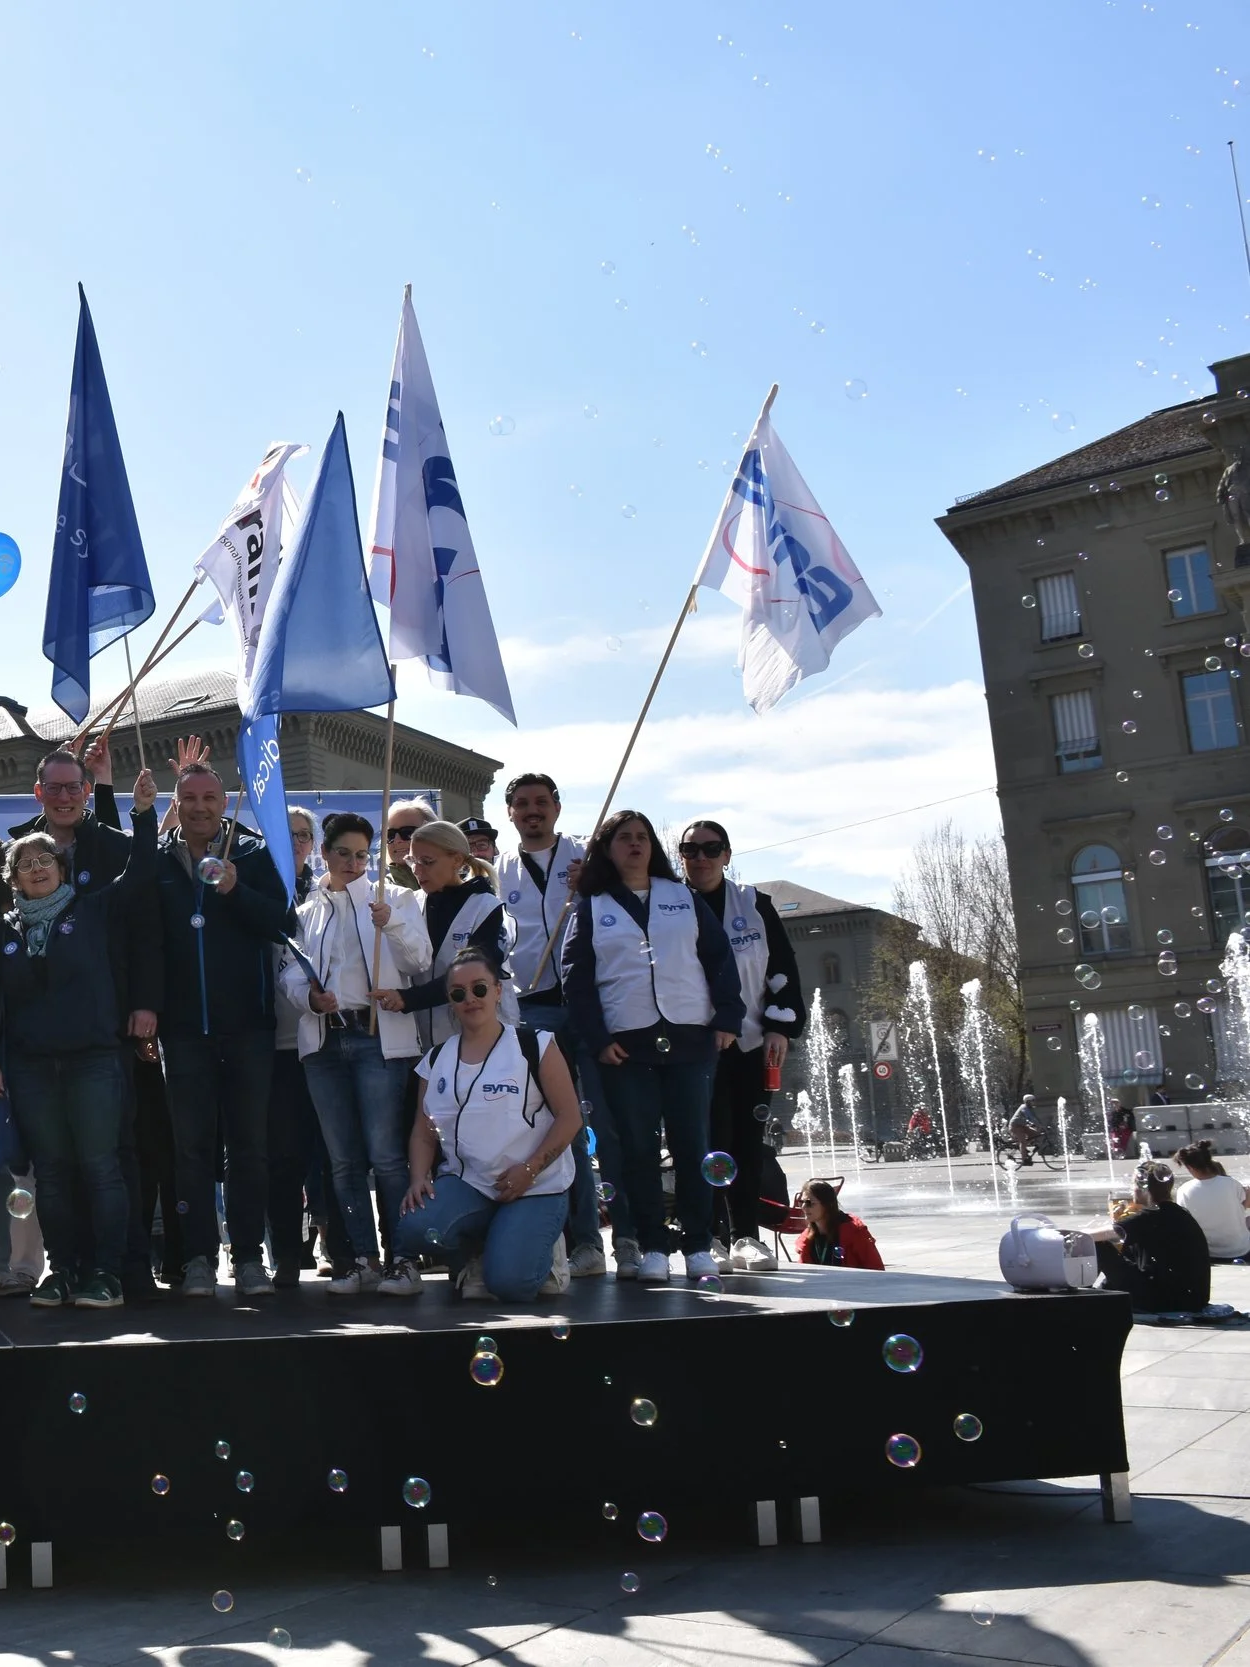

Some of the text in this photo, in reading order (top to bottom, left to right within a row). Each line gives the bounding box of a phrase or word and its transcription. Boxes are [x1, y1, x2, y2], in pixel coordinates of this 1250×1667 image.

[658, 903, 690, 911] syna
[453, 932, 471, 943] syn
[731, 932, 761, 945] syna
[482, 1083, 519, 1094] syna
